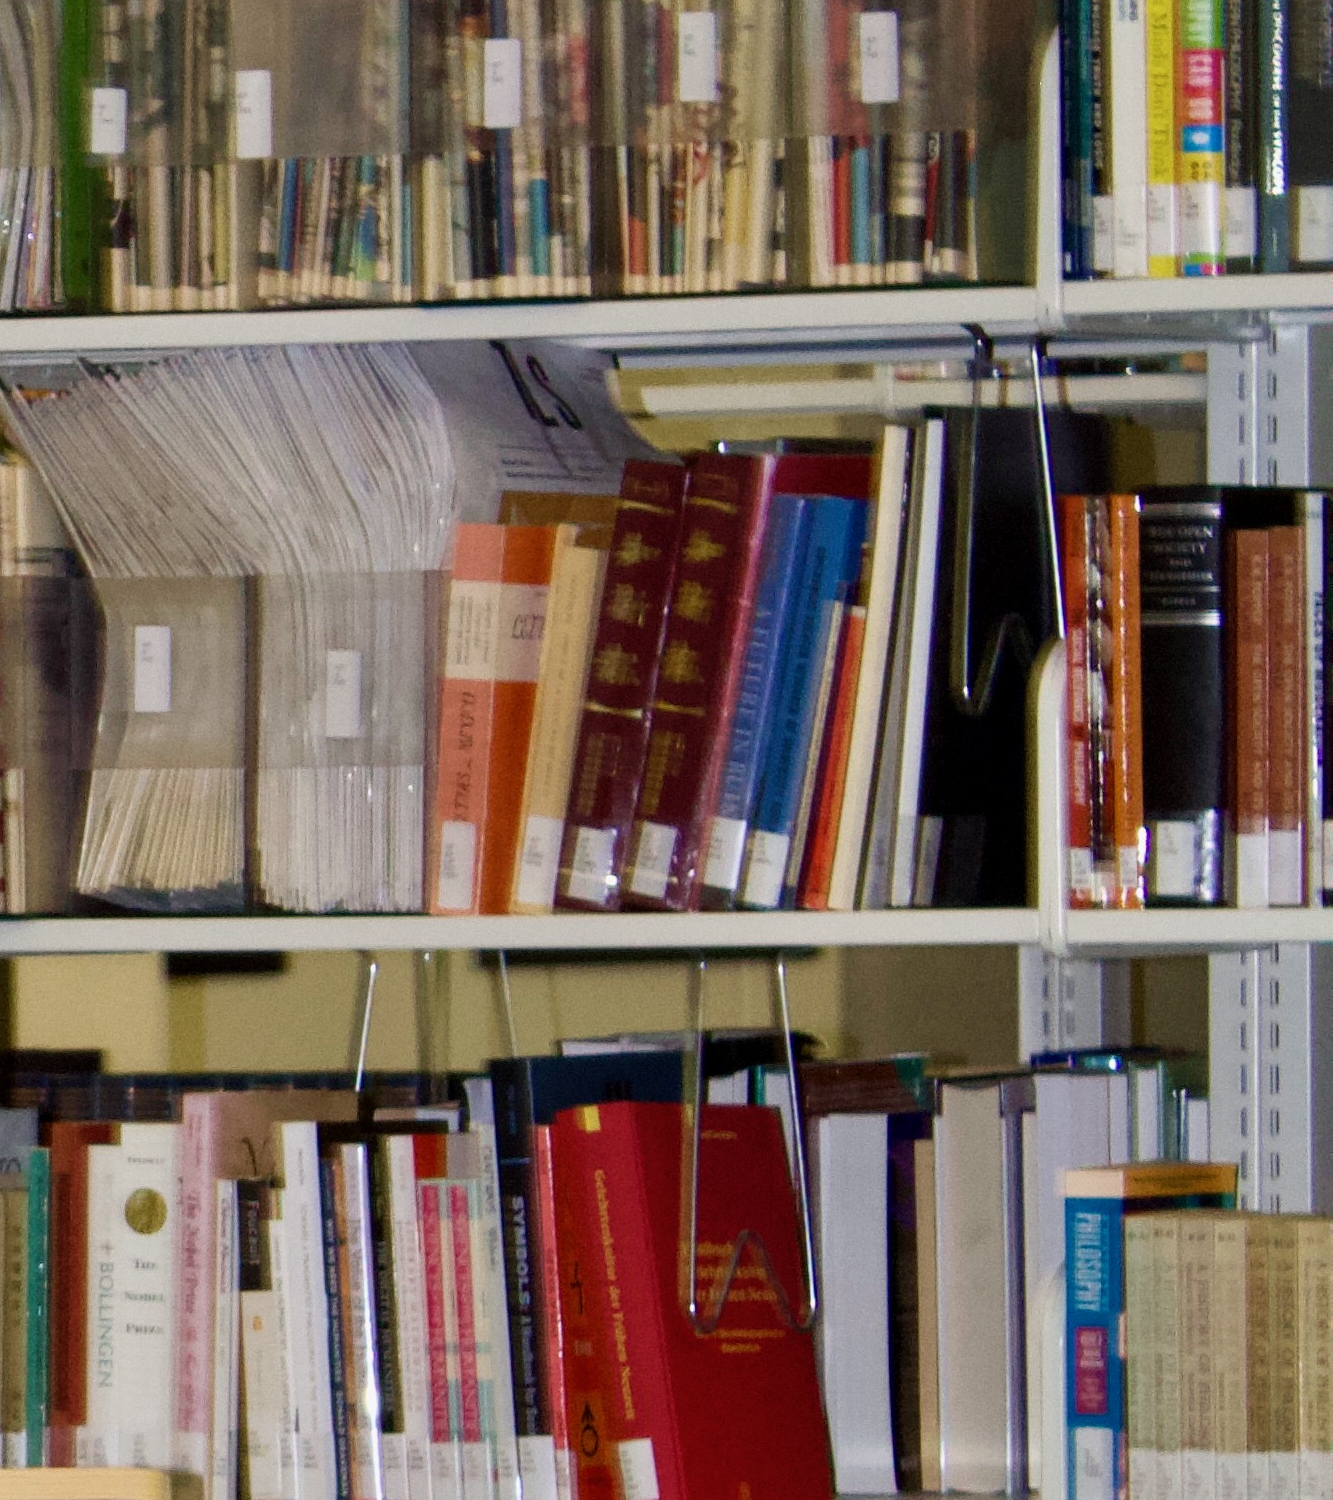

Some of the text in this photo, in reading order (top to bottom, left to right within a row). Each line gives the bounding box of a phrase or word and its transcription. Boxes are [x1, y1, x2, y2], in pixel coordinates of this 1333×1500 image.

[1152, 126, 1170, 179] Think
[1074, 1212, 1103, 1312] PHILOSOPHY
[97, 1261, 114, 1388] BOLLINGEN
